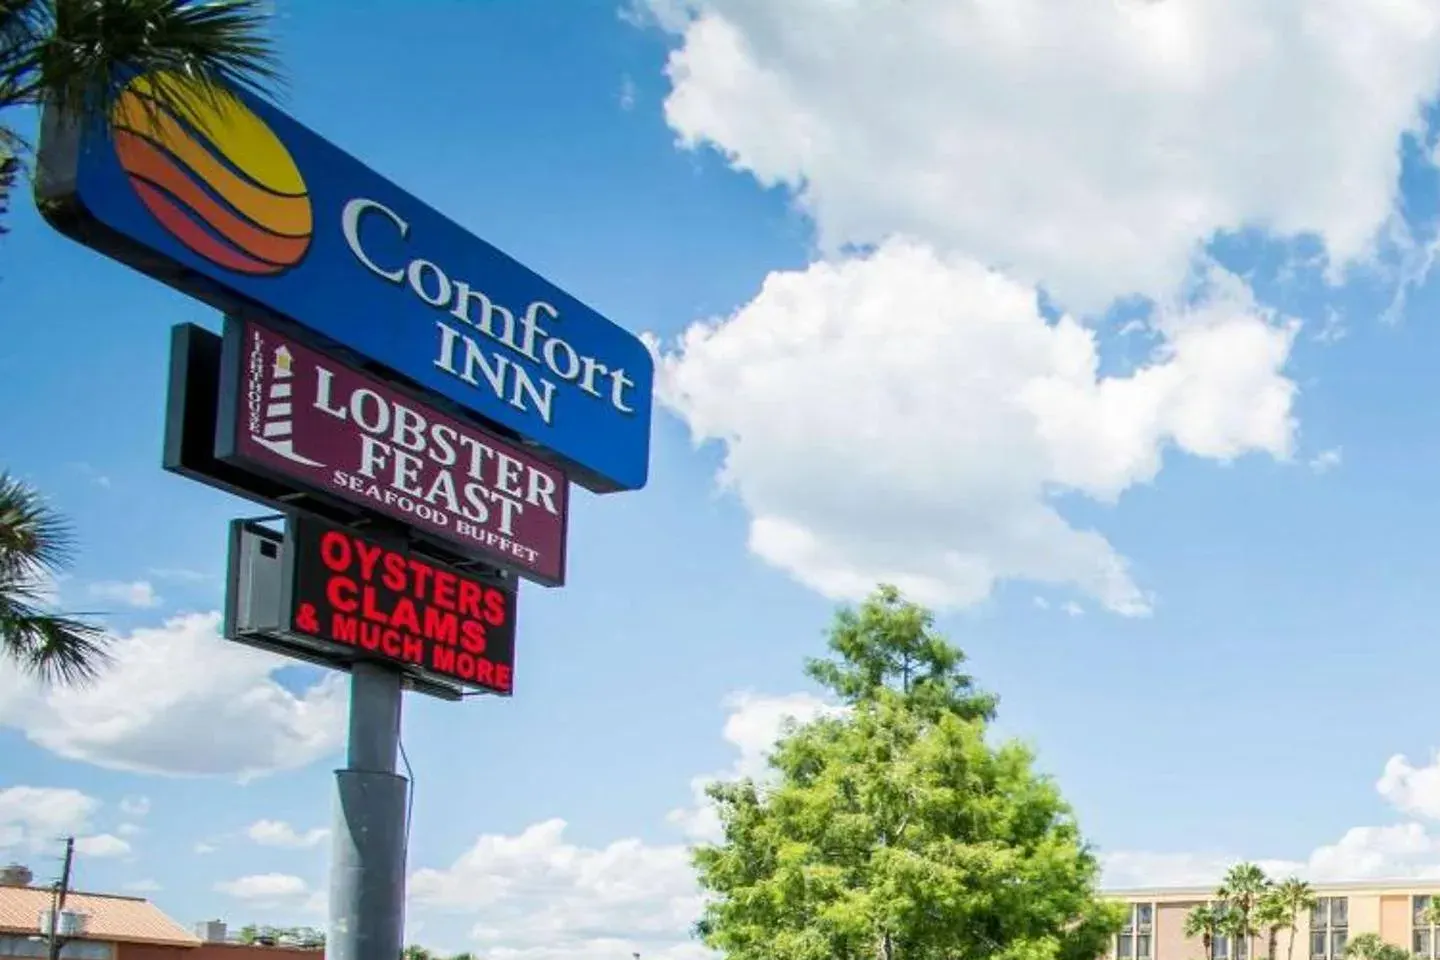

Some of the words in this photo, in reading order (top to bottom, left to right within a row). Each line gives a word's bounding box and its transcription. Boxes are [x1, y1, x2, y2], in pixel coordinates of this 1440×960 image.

[342, 198, 635, 413] Comfort
[433, 321, 556, 424] INN
[313, 366, 559, 515] LOBSTER
[358, 433, 523, 536] FEAST
[333, 470, 448, 526] SEAFOOD
[456, 519, 539, 562] BUFFET
[320, 531, 506, 626] OYSTERS
[327, 576, 487, 654] CLAMS
[296, 603, 320, 634] &
[332, 614, 424, 665] MUCH
[433, 644, 513, 690] MORE
